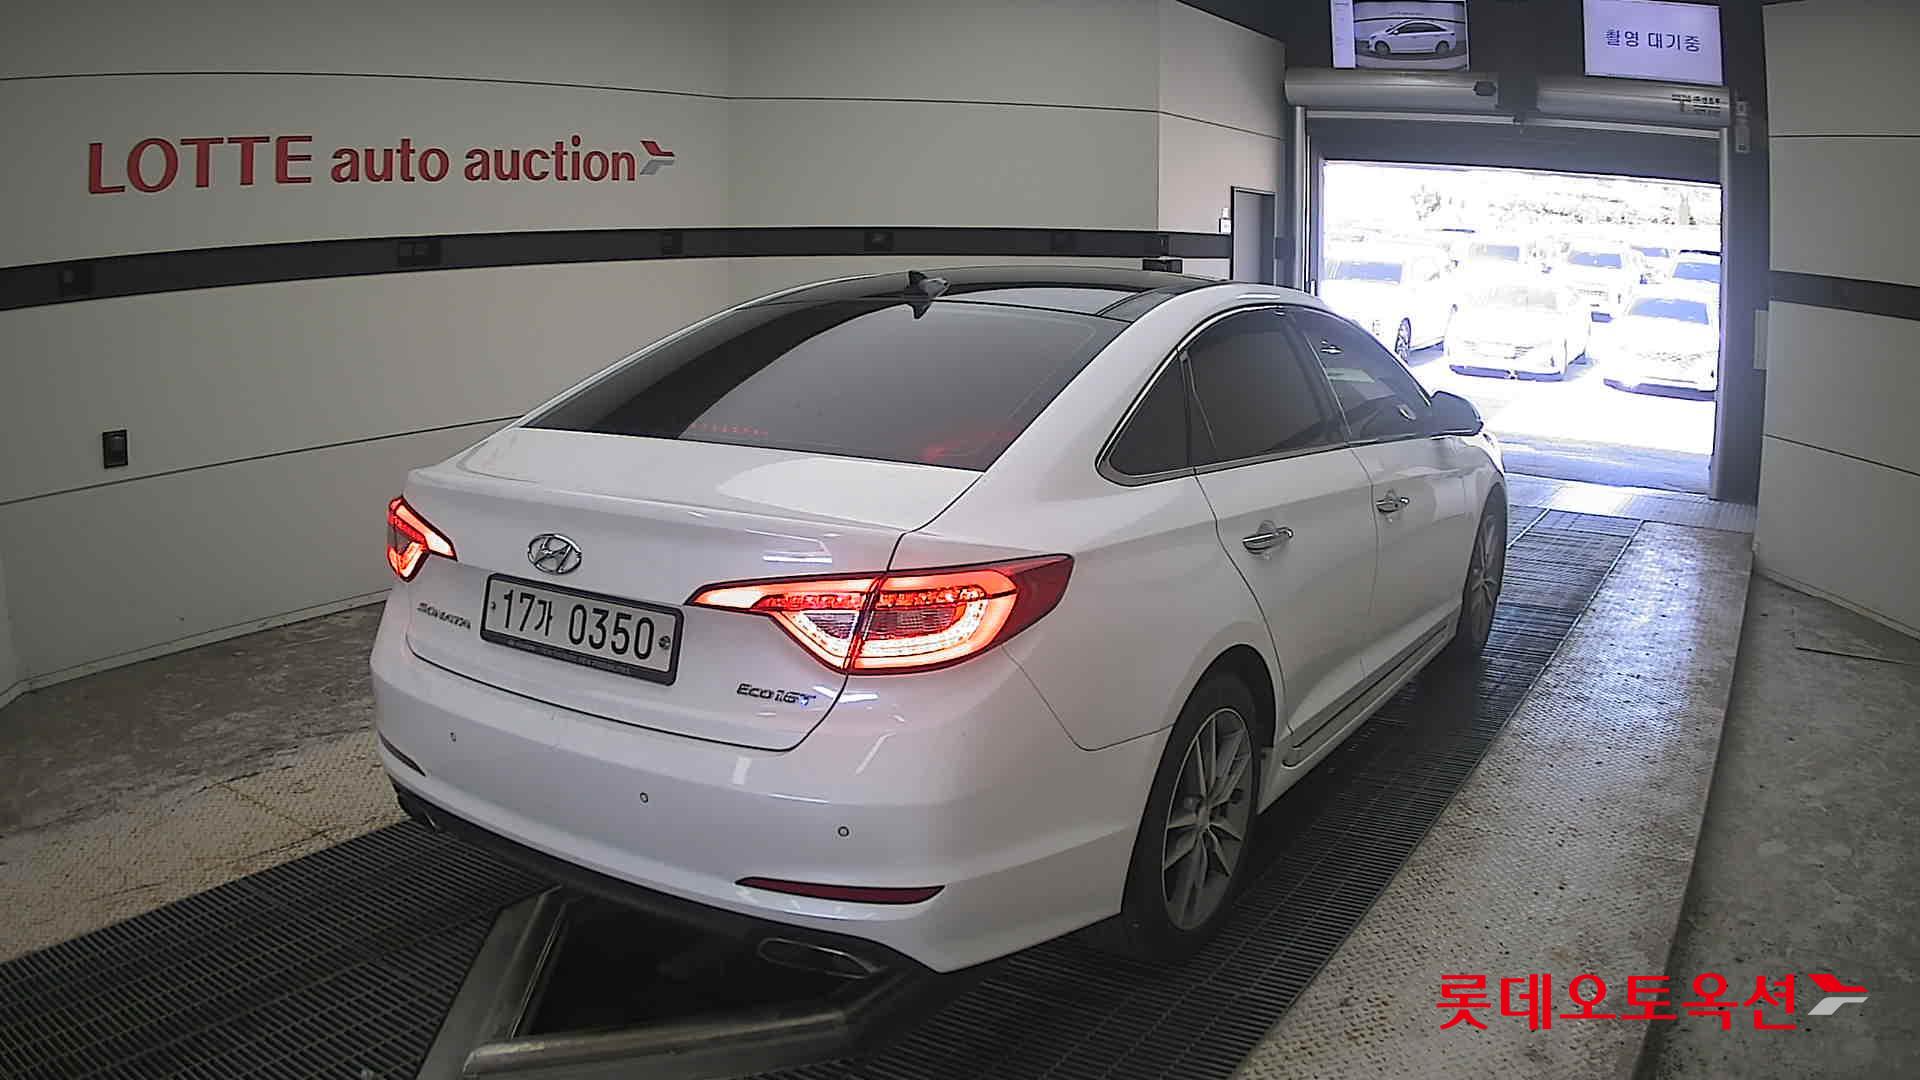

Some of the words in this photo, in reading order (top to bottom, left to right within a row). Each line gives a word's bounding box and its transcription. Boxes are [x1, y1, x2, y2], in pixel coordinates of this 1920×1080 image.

[1647, 32, 1701, 52] 대기중
[88, 136, 313, 194] LOTTE
[331, 138, 450, 182] auto
[463, 134, 637, 182] auction
[503, 589, 552, 636] 17가
[568, 604, 655, 660] 0350
